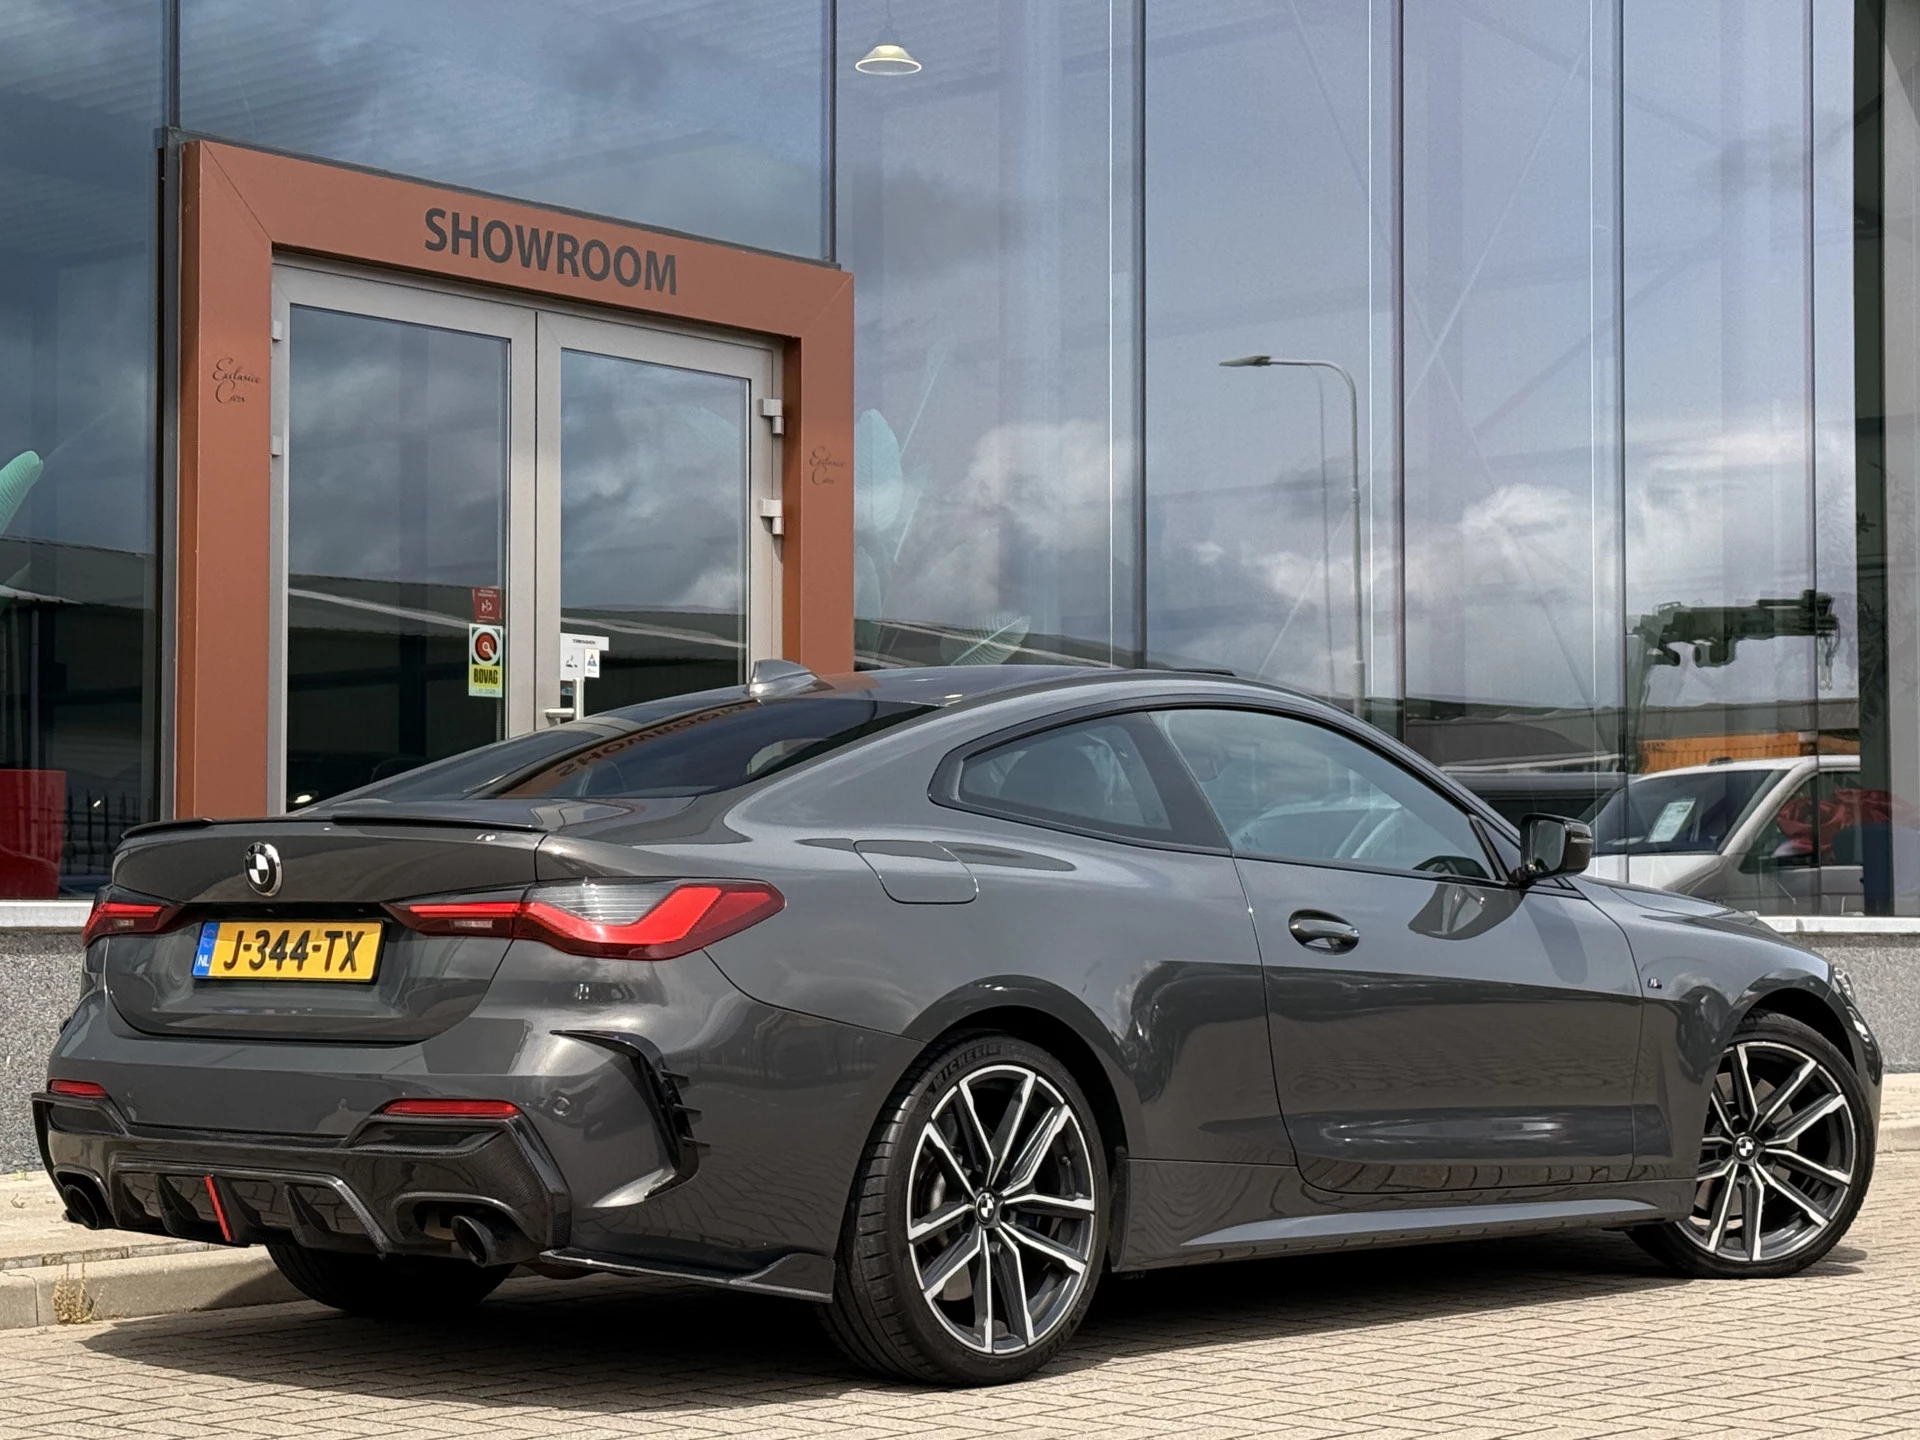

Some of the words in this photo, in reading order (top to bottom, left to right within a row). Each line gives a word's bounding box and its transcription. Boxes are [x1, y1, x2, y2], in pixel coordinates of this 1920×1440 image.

[424, 207, 678, 295] SHOWROOM
[473, 668, 499, 685] BOVAG
[197, 954, 210, 967] NL
[223, 929, 365, 973] J-344-TX
